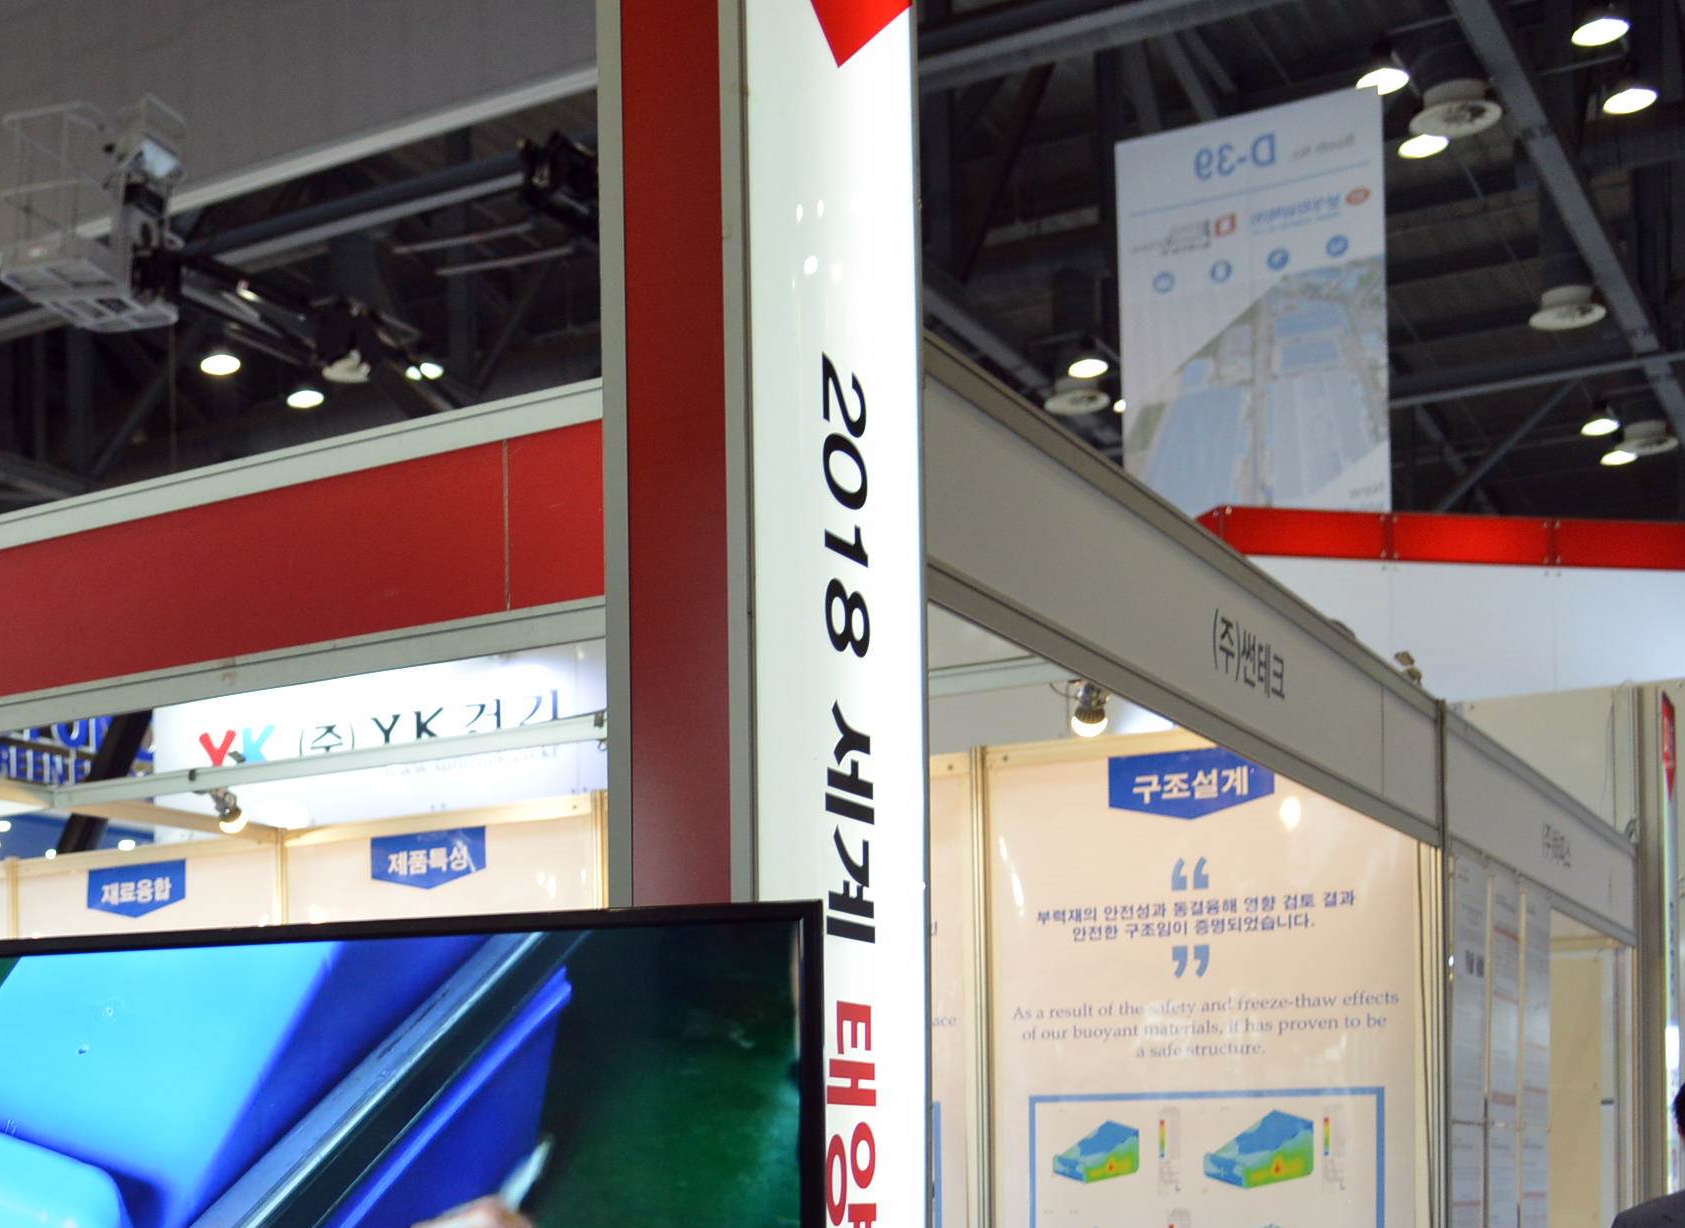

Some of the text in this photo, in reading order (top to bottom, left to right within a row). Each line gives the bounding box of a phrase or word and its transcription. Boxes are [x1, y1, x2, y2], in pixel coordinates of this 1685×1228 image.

[821, 352, 870, 658] 2018
[1213, 607, 1285, 699] (주)썬테크
[1132, 765, 1249, 805] 구조설계
[824, 699, 876, 944] 세계
[387, 840, 470, 876] 제품특성
[1322, 889, 1356, 908] 결과
[1073, 924, 1119, 943] 안전한
[1013, 1006, 1032, 1021] As
[1049, 1002, 1093, 1019] result
[1098, 1002, 1114, 1017] of
[1118, 1000, 1144, 1016] the
[1148, 998, 1196, 1017] safety
[1201, 997, 1232, 1013] and
[1238, 992, 1337, 1011] freeze-thaw
[1343, 989, 1400, 1007] effects
[1022, 1025, 1038, 1041] of
[1041, 1028, 1067, 1040] our
[1072, 1024, 1138, 1043] buoyant
[1143, 1019, 1224, 1037] materials,
[1245, 1017, 1273, 1034] has
[1278, 1016, 1339, 1036] proven
[1344, 1014, 1361, 1030] to
[1366, 1012, 1388, 1028] be
[1149, 1042, 1182, 1058] safe
[1186, 1041, 1266, 1057] structure.
